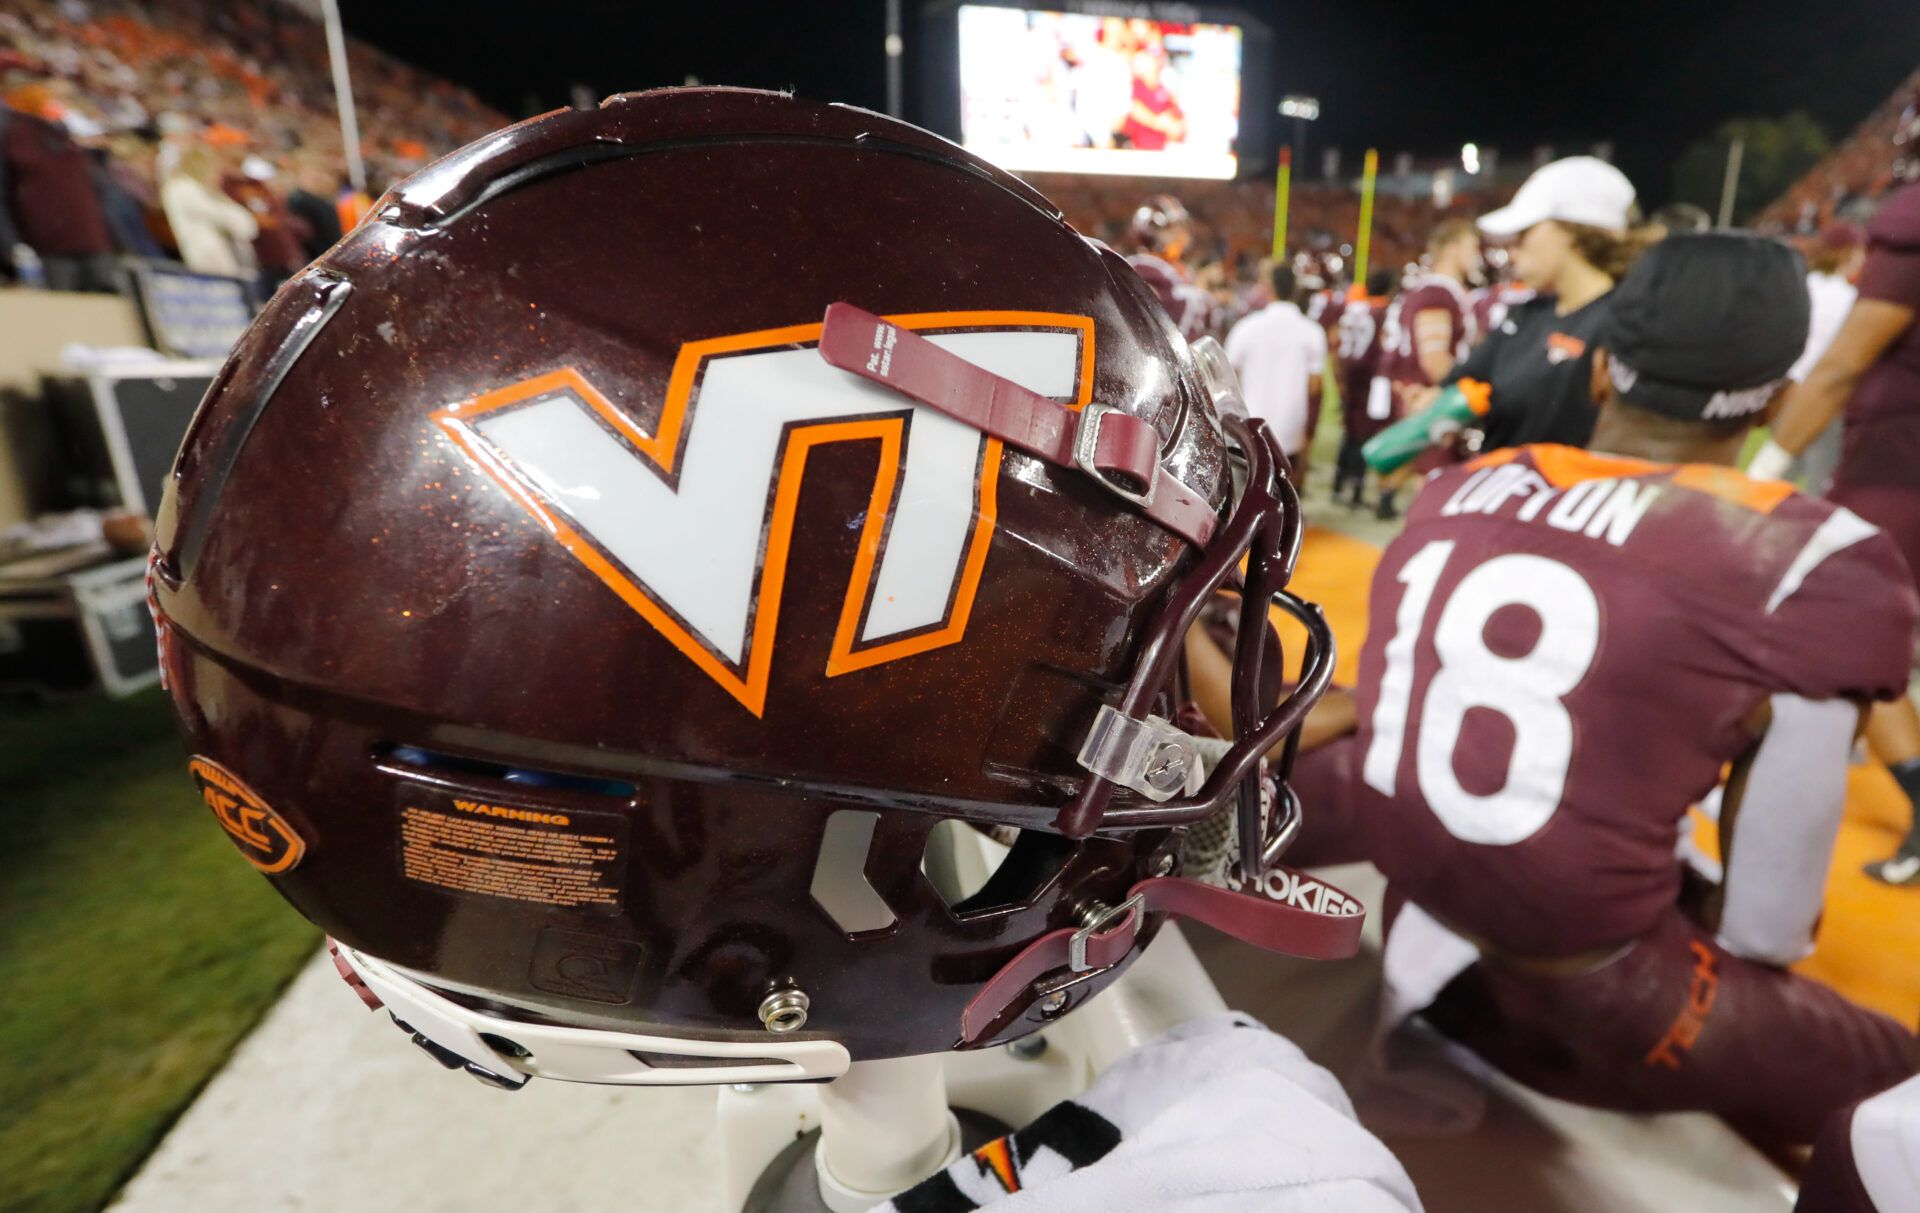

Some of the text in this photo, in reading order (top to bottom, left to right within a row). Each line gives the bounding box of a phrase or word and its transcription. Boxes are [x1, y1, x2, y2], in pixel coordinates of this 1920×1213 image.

[430, 311, 1096, 720] VT
[1440, 463, 1662, 547] LOFTON
[1363, 540, 1600, 846] 18
[203, 786, 273, 853] ACC
[453, 799, 570, 826] WARNING
[1646, 940, 1718, 1068] TECH
